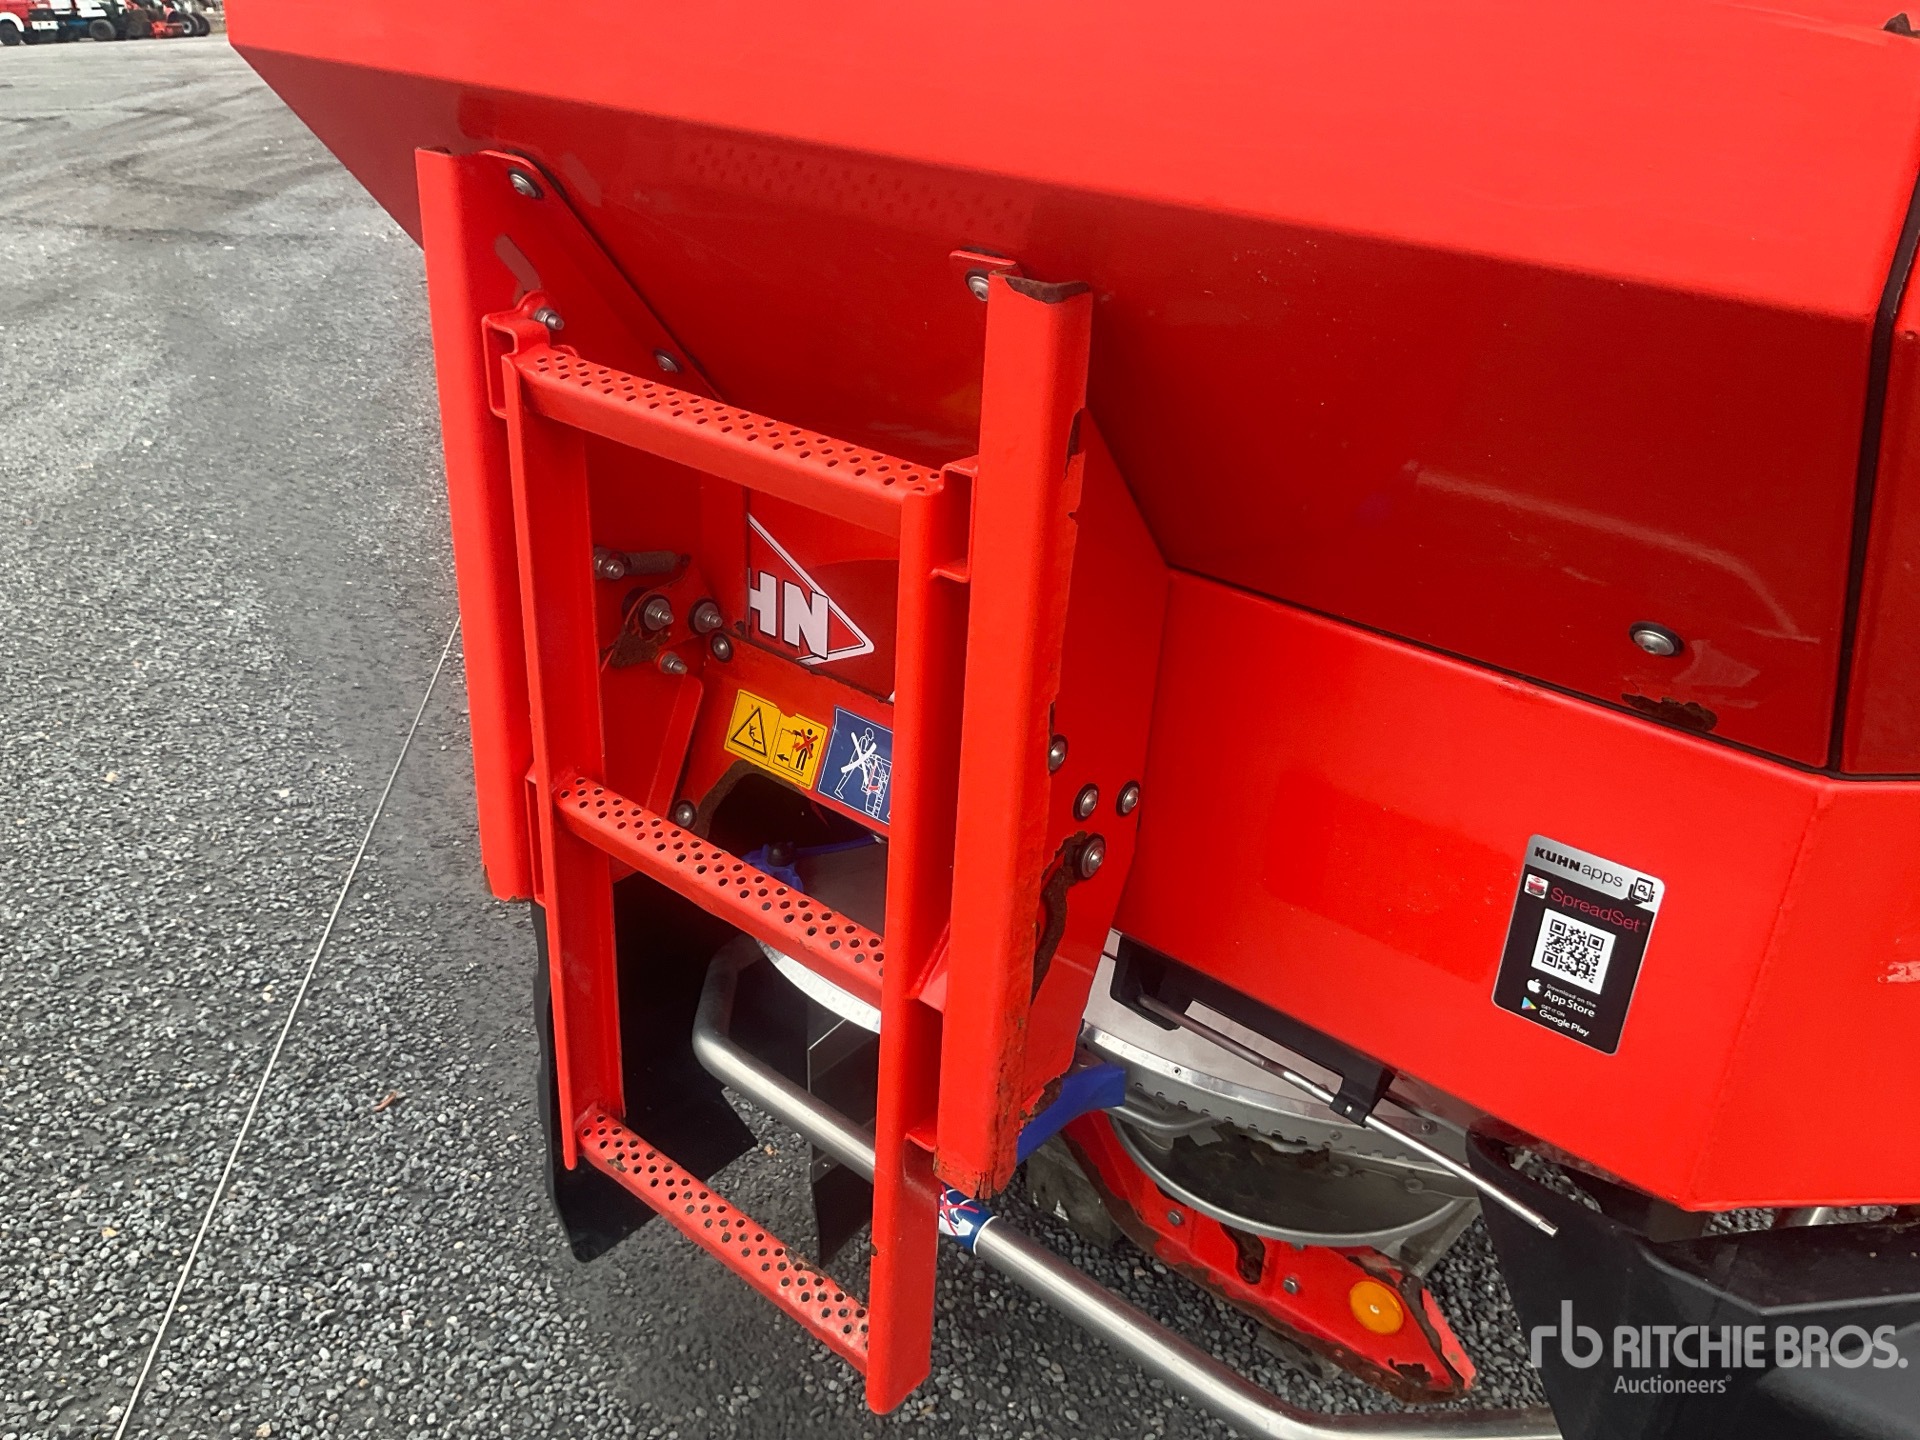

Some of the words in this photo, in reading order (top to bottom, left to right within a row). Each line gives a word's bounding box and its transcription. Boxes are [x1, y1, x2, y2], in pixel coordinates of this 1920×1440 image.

[1544, 990, 1566, 1006] App
[1566, 999, 1595, 1018] Store
[1546, 983, 1577, 1000] Download
[1586, 1000, 1597, 1008] the
[1539, 1009, 1570, 1029] Google
[1570, 1022, 1590, 1037] Play
